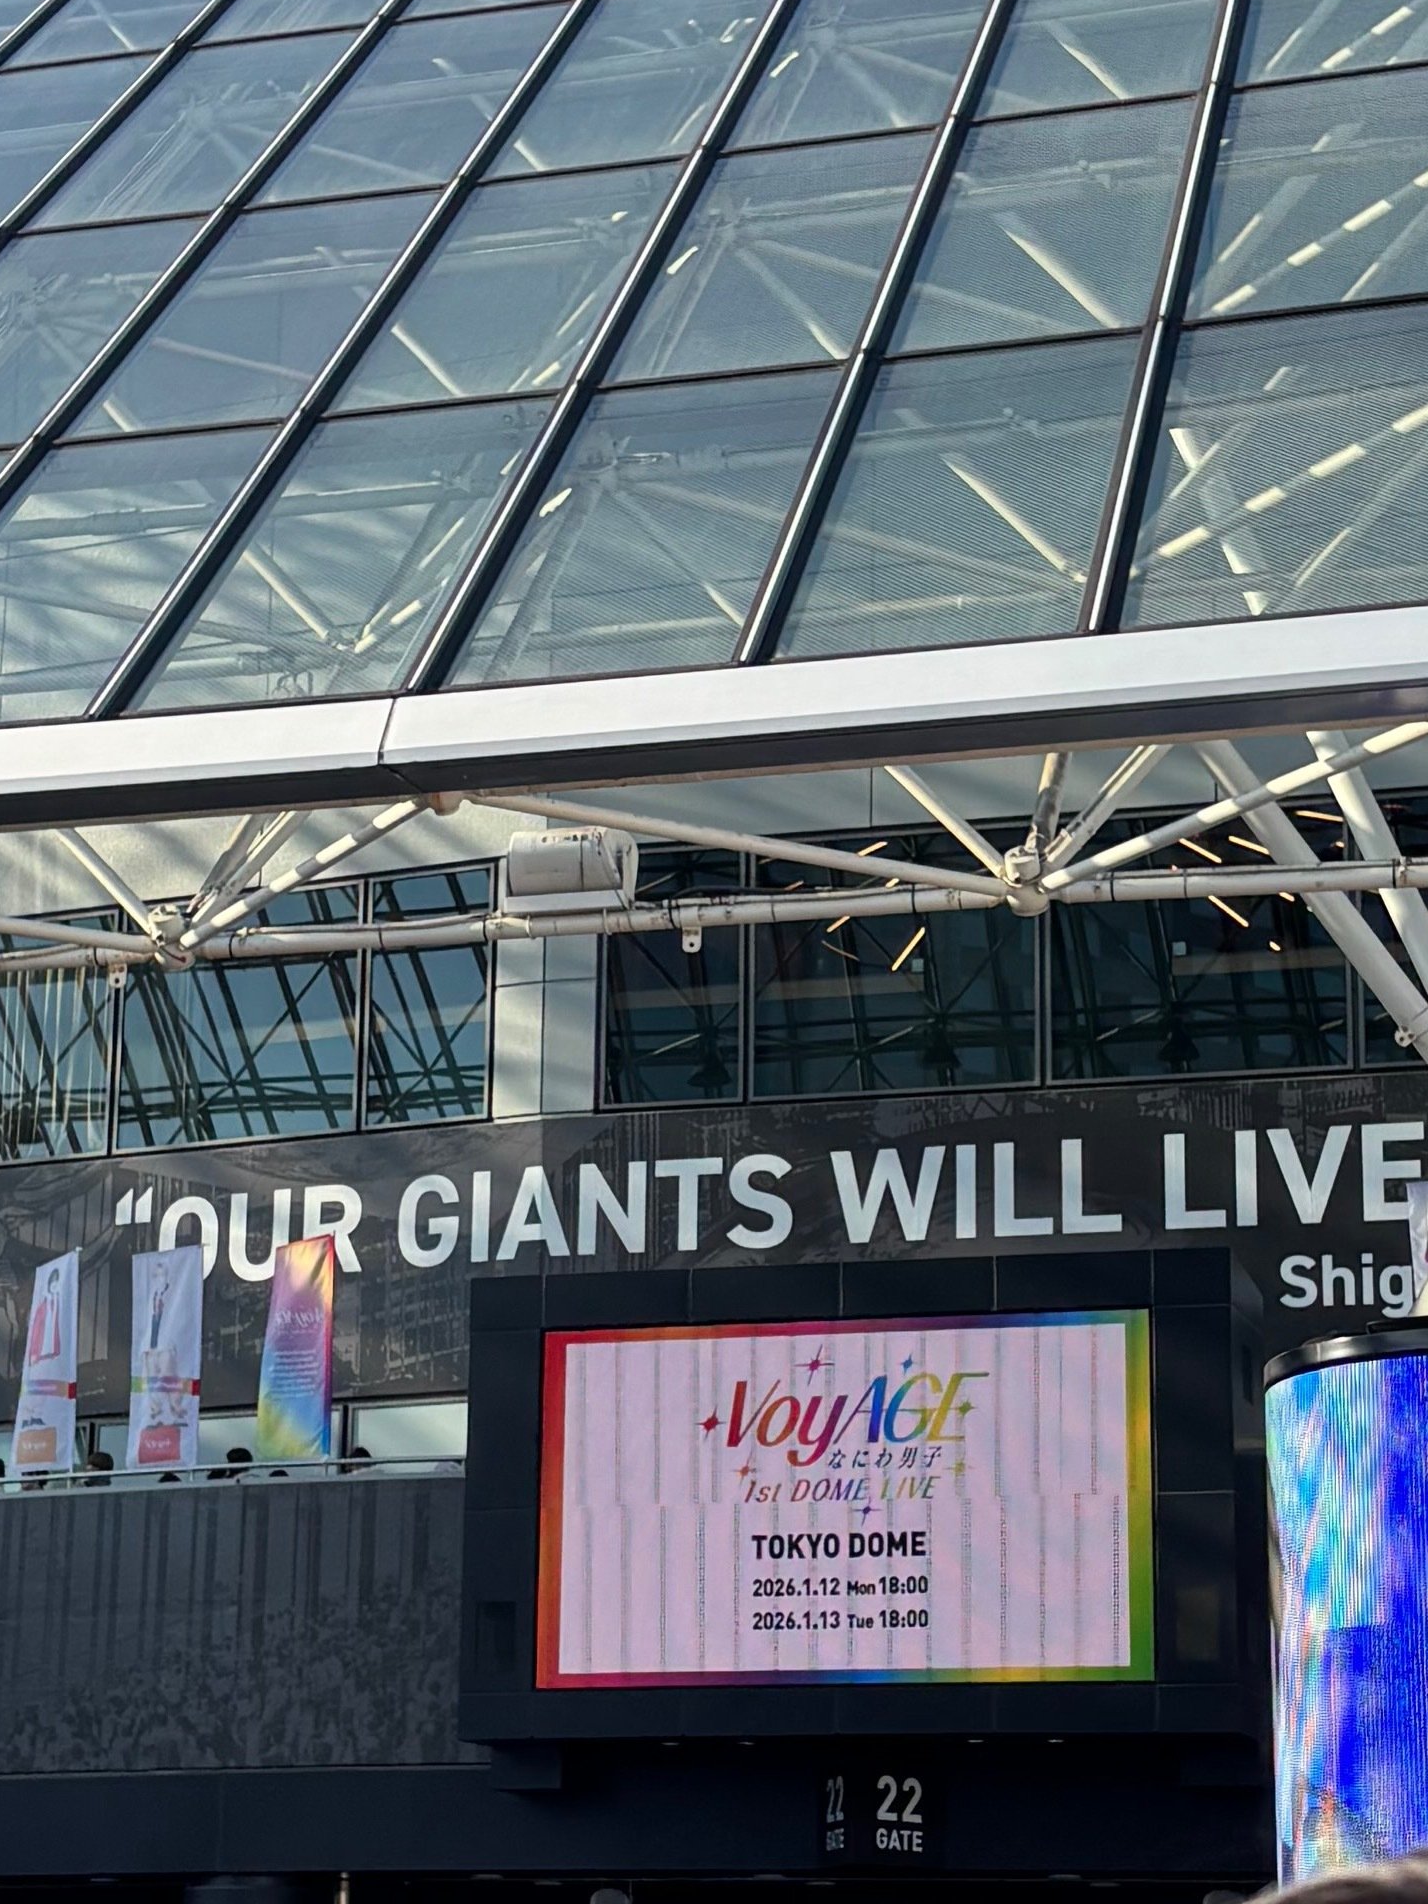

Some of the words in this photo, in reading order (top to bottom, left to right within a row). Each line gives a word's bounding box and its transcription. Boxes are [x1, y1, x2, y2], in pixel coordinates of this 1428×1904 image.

[397, 1154, 794, 1267] GIANTS
[830, 1139, 1122, 1243] WILL
[1163, 1121, 1425, 1230] LIVE
[1279, 1253, 1414, 1318] Shig
[827, 1447, 943, 1470] なにわ男子
[744, 1479, 781, 1503] 1st
[790, 1478, 871, 1502] DOME
[880, 1476, 942, 1501] LIVE
[751, 1533, 841, 1559] TOKYO
[848, 1531, 927, 1558] DOME
[752, 1577, 841, 1597] 2026.1.12
[847, 1580, 876, 1596] Mon
[879, 1575, 929, 1595] 18:00
[752, 1610, 841, 1630] 2026.1.13
[847, 1613, 875, 1629] Tue
[879, 1609, 929, 1628] 18:00
[876, 1775, 923, 1824] 22
[876, 1827, 924, 1853] GATE
